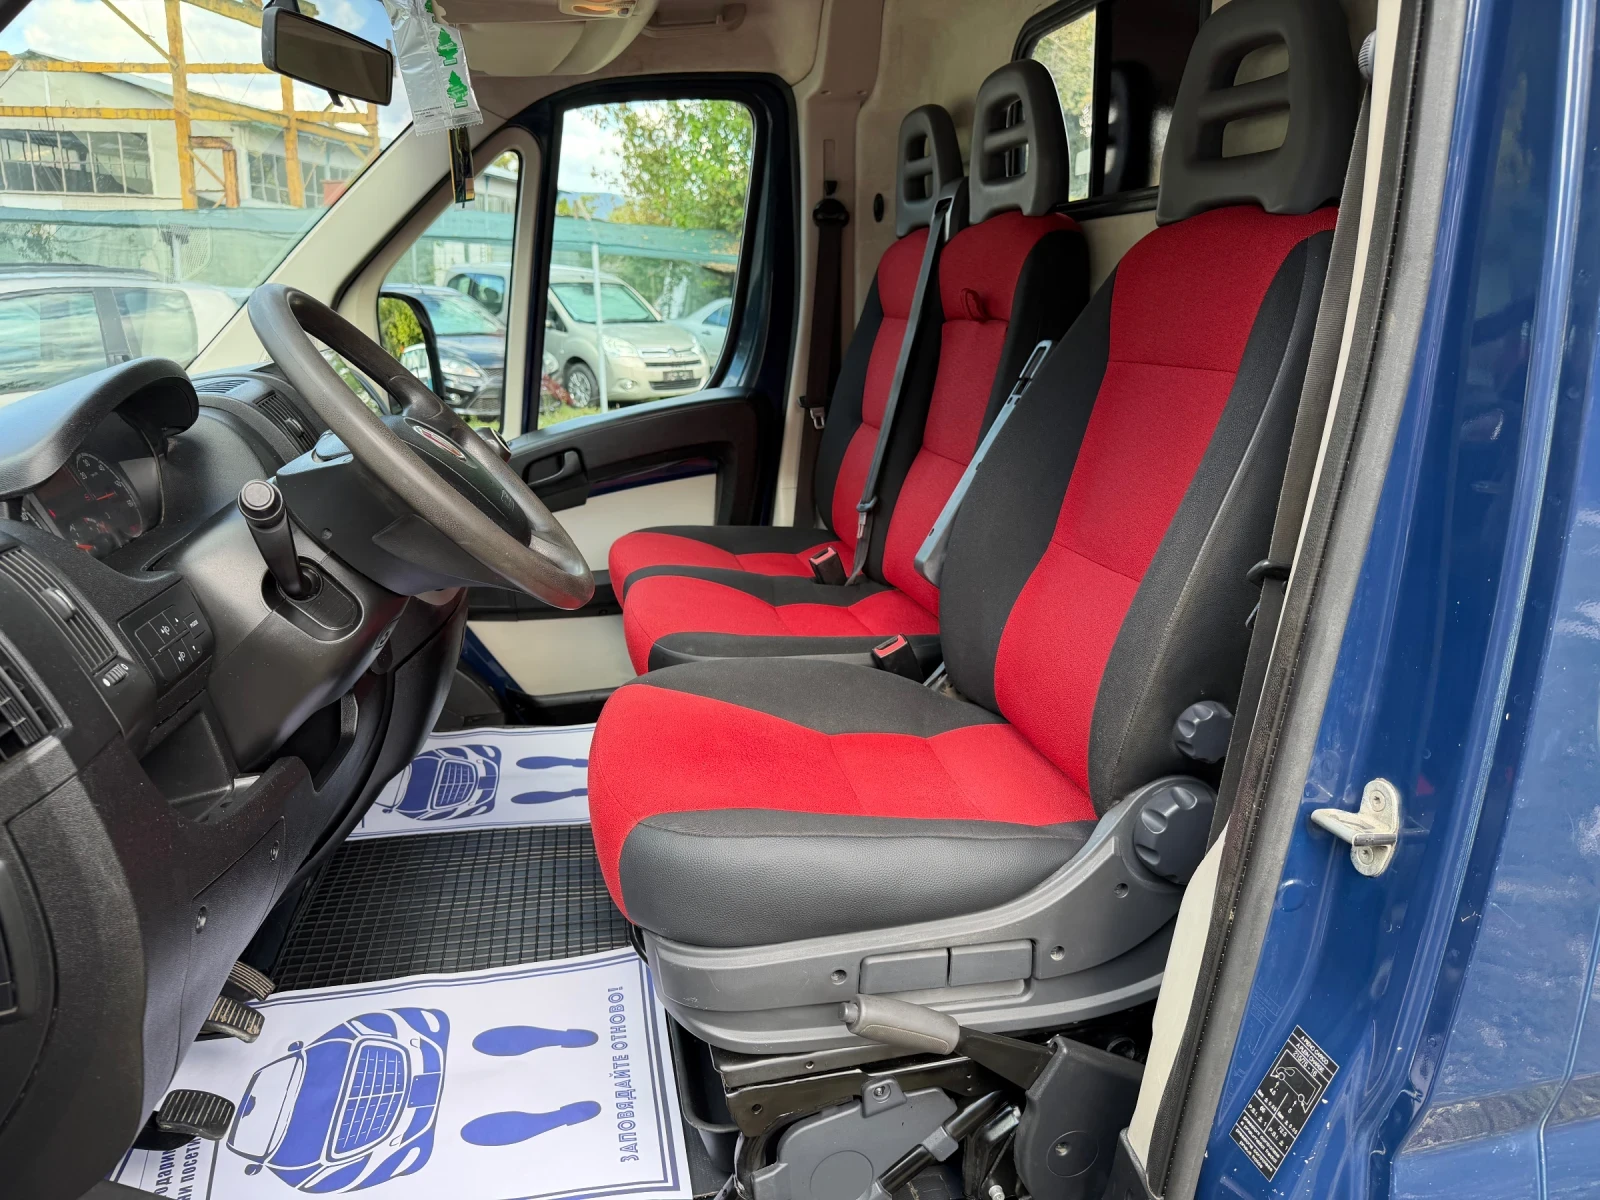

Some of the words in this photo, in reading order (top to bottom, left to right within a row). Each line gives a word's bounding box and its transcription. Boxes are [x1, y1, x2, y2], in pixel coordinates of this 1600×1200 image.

[608, 986, 629, 1051] ОТНОВО!
[609, 1054, 639, 1163] ЗАПОВЯДАЙТЕ
[154, 1149, 176, 1196] одари
[180, 1137, 202, 1183] посети
